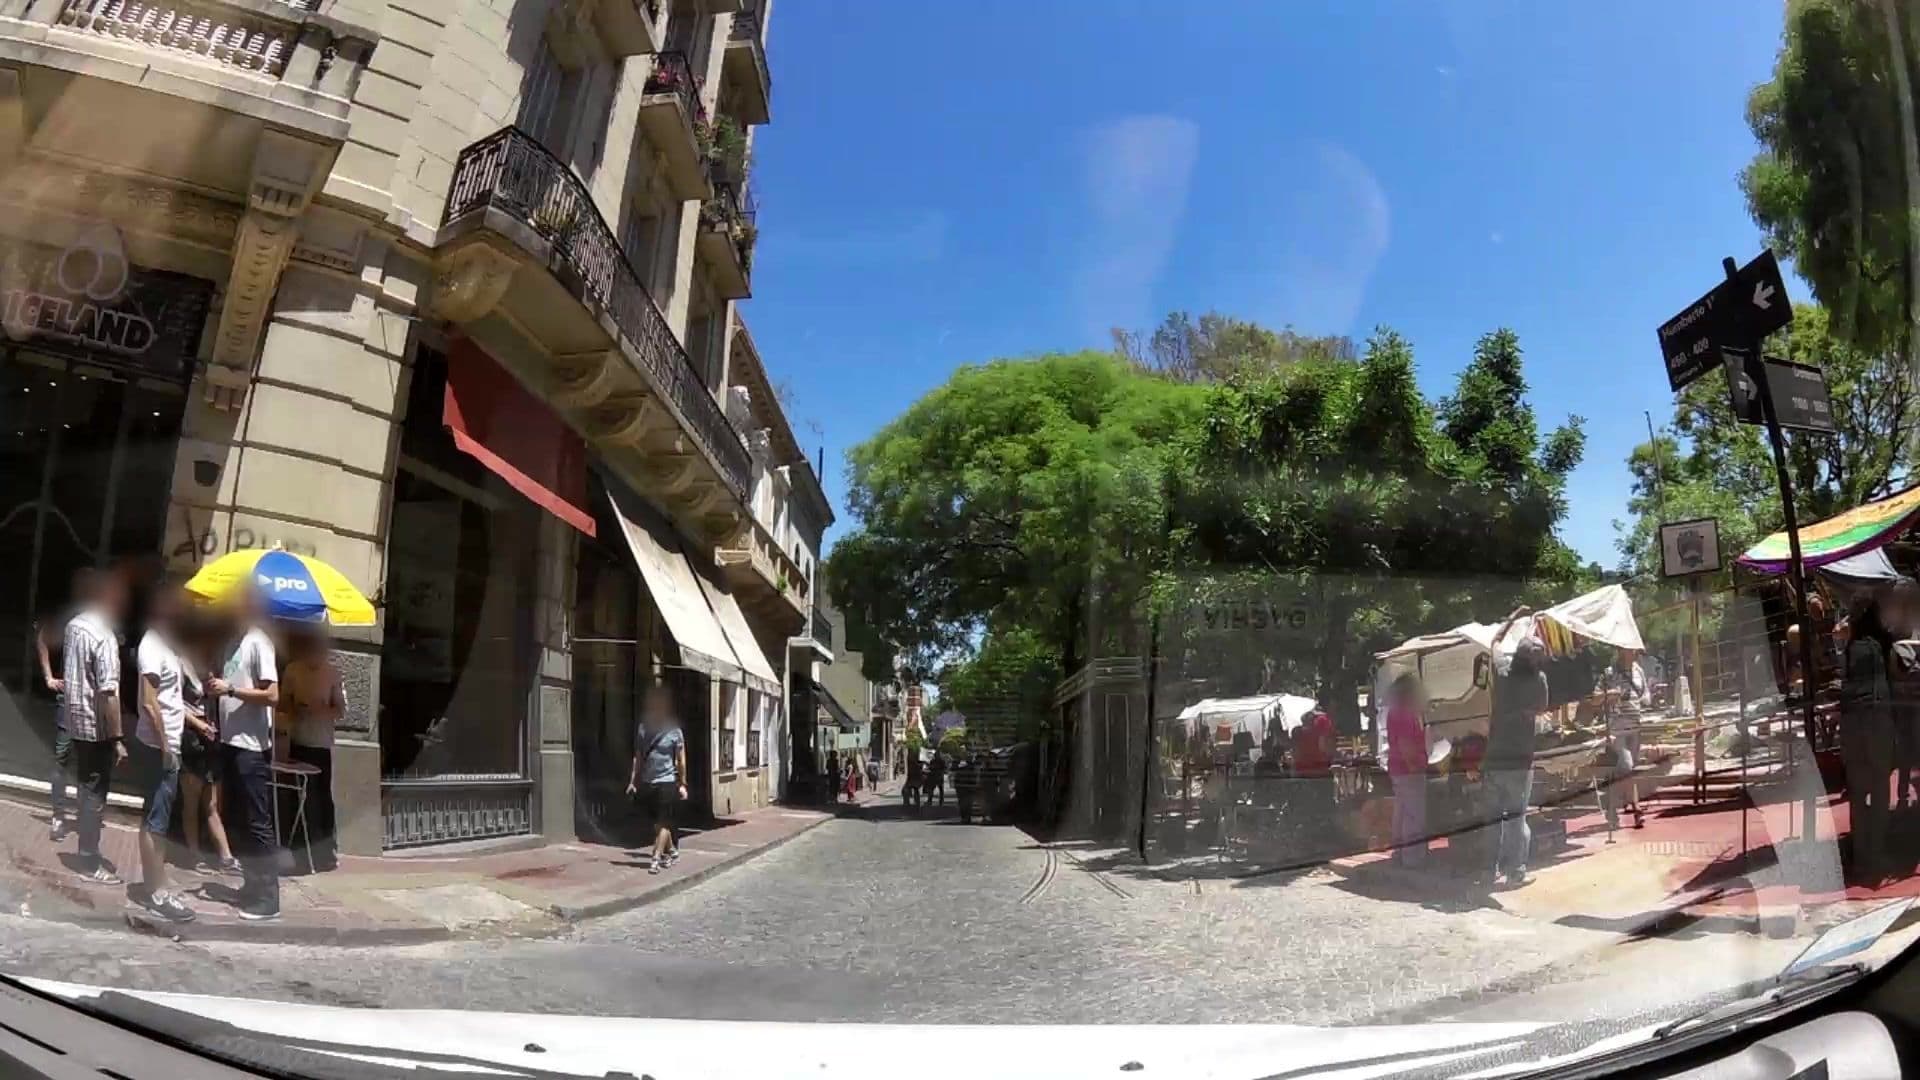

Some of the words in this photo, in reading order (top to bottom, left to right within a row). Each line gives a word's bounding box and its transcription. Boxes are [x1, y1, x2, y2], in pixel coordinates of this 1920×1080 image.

[4, 290, 155, 353] ICELAND
[1662, 305, 1705, 340] Humberto
[274, 576, 308, 592] pro
